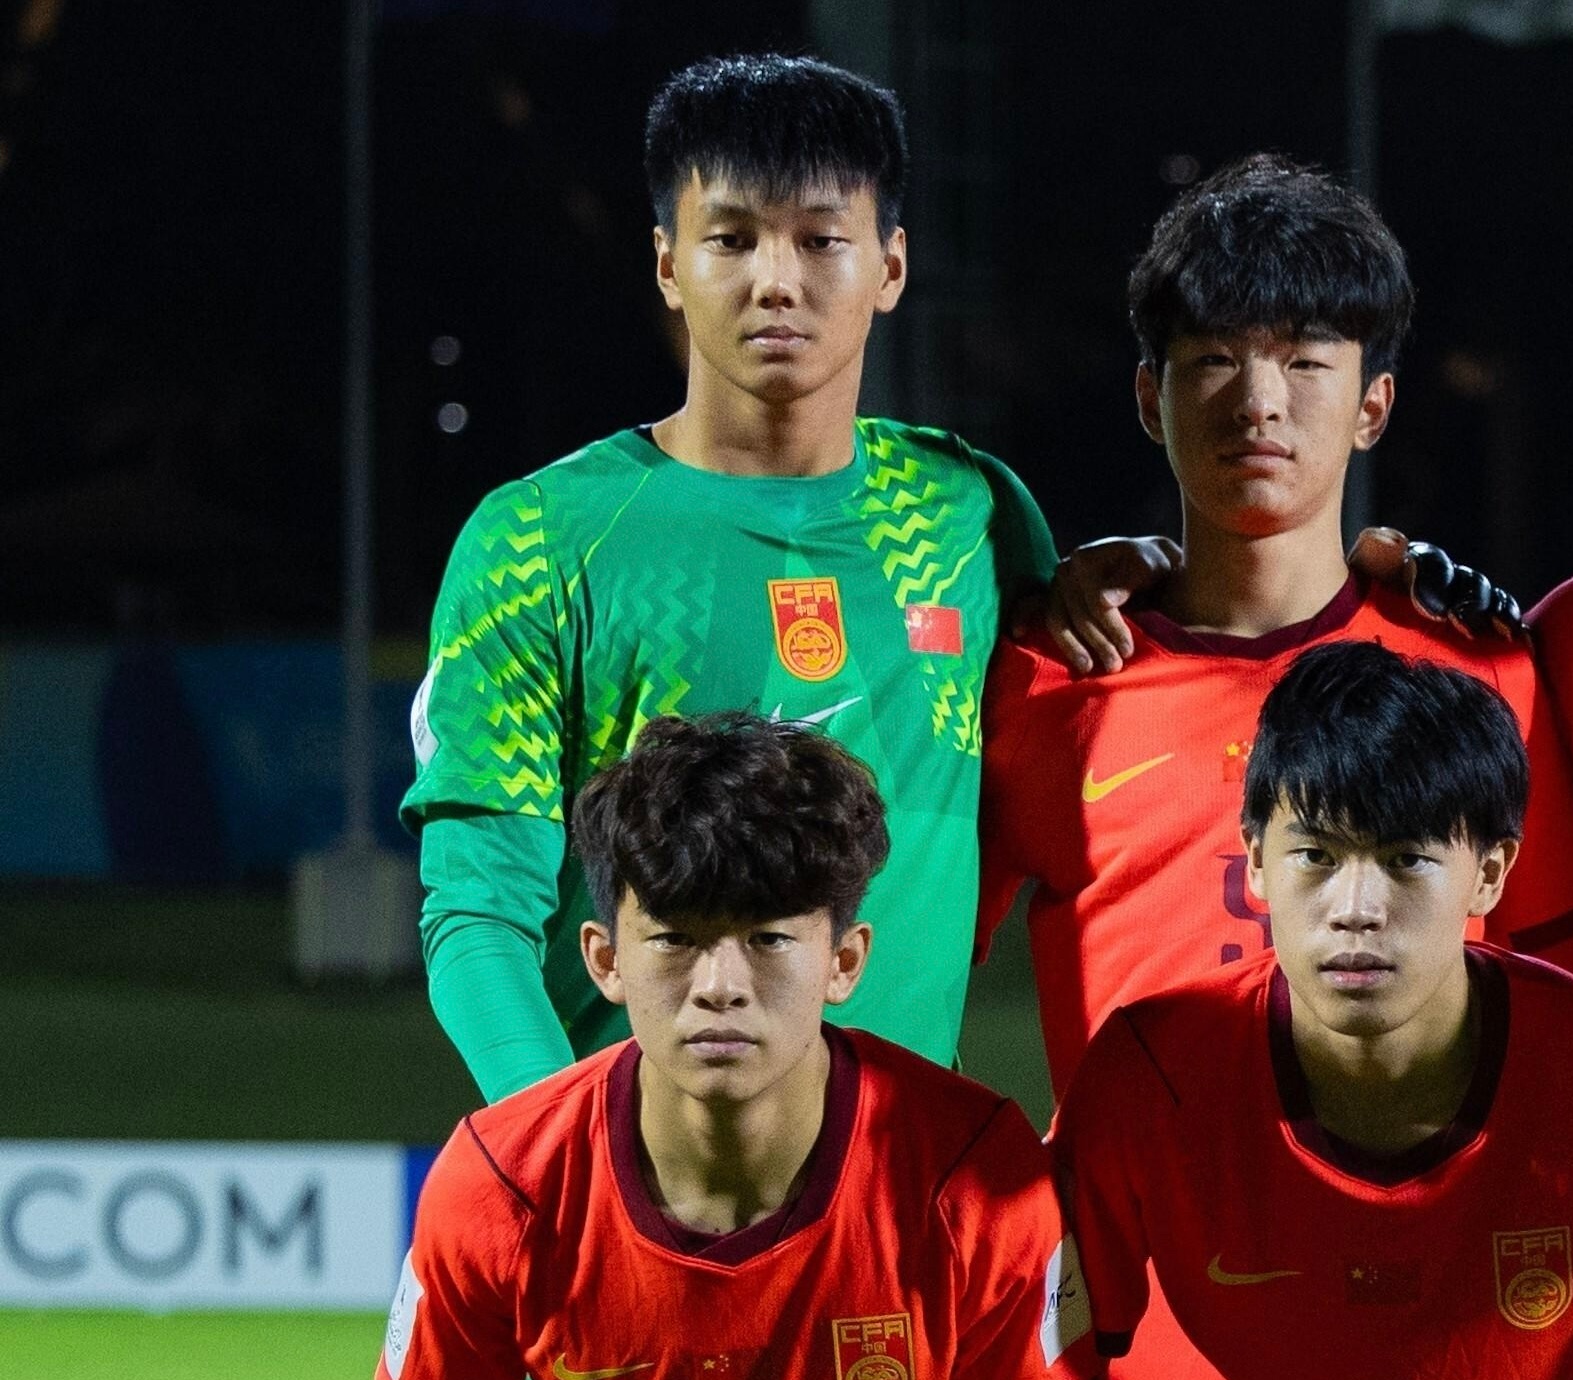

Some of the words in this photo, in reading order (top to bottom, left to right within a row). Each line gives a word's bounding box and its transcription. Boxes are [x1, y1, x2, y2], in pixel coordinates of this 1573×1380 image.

[775, 584, 834, 605] CFA
[1, 1168, 326, 1284] COM
[1501, 1234, 1564, 1256] CFA
[1044, 1274, 1076, 1319] AFC
[841, 1321, 905, 1343] CFA
